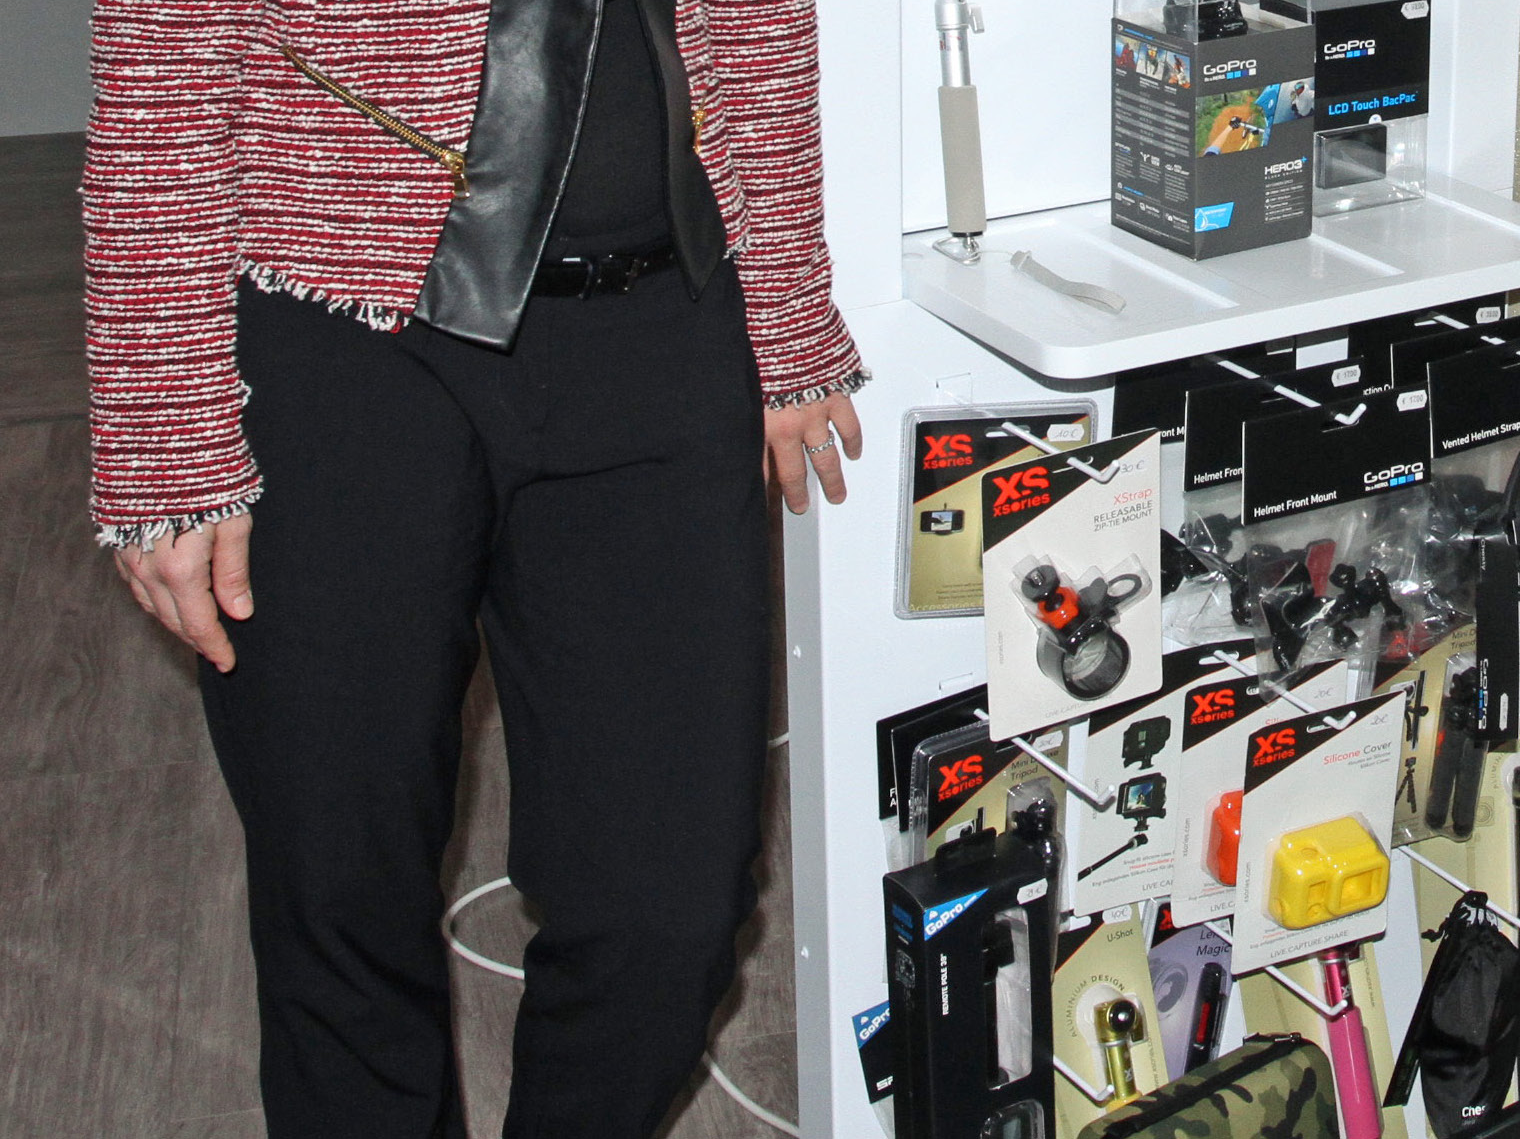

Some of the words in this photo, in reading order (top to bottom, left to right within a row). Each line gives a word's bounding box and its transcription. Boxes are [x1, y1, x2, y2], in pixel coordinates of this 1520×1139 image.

[1324, 39, 1376, 54] GoPro
[1203, 59, 1257, 76] GoPro
[1328, 102, 1349, 116] LCD
[1351, 98, 1380, 112] Touch
[1383, 93, 1416, 108] BacPac
[1160, 427, 1175, 438] ront
[1442, 434, 1470, 450] Vented
[1471, 426, 1499, 441] Helmet
[924, 434, 974, 461] XS
[923, 456, 974, 470] xsories
[1363, 462, 1424, 484] GoPro
[992, 466, 1051, 507] XS
[1193, 470, 1223, 484] Helmet
[1224, 467, 1243, 478] Fron
[992, 493, 1052, 517] xsories
[1113, 488, 1153, 506] XStrap
[1254, 502, 1285, 518] Helmet
[1286, 497, 1309, 511] Front
[1310, 490, 1337, 505] Mount
[1093, 500, 1153, 524] RELEASABLE
[1093, 517, 1120, 532] ZIP-TIE
[1121, 509, 1153, 525] MOUNT
[1191, 688, 1235, 718] XS
[1190, 709, 1235, 725] xsories
[1253, 728, 1296, 758] XS
[1323, 750, 1361, 765] Silicone
[1363, 742, 1392, 755] Cover
[1011, 759, 1029, 770] Mini
[1253, 748, 1296, 767] xsories
[938, 754, 984, 792] XS
[1011, 765, 1038, 781] Tripod
[938, 775, 984, 801] xsories
[1142, 883, 1157, 891] LIVE
[924, 903, 964, 936] GoPro
[1106, 928, 1134, 943] U-Shot
[1196, 944, 1230, 957] Magic
[1066, 980, 1088, 1038] ALUMINIUM
[1091, 974, 1125, 992] DESIGN
